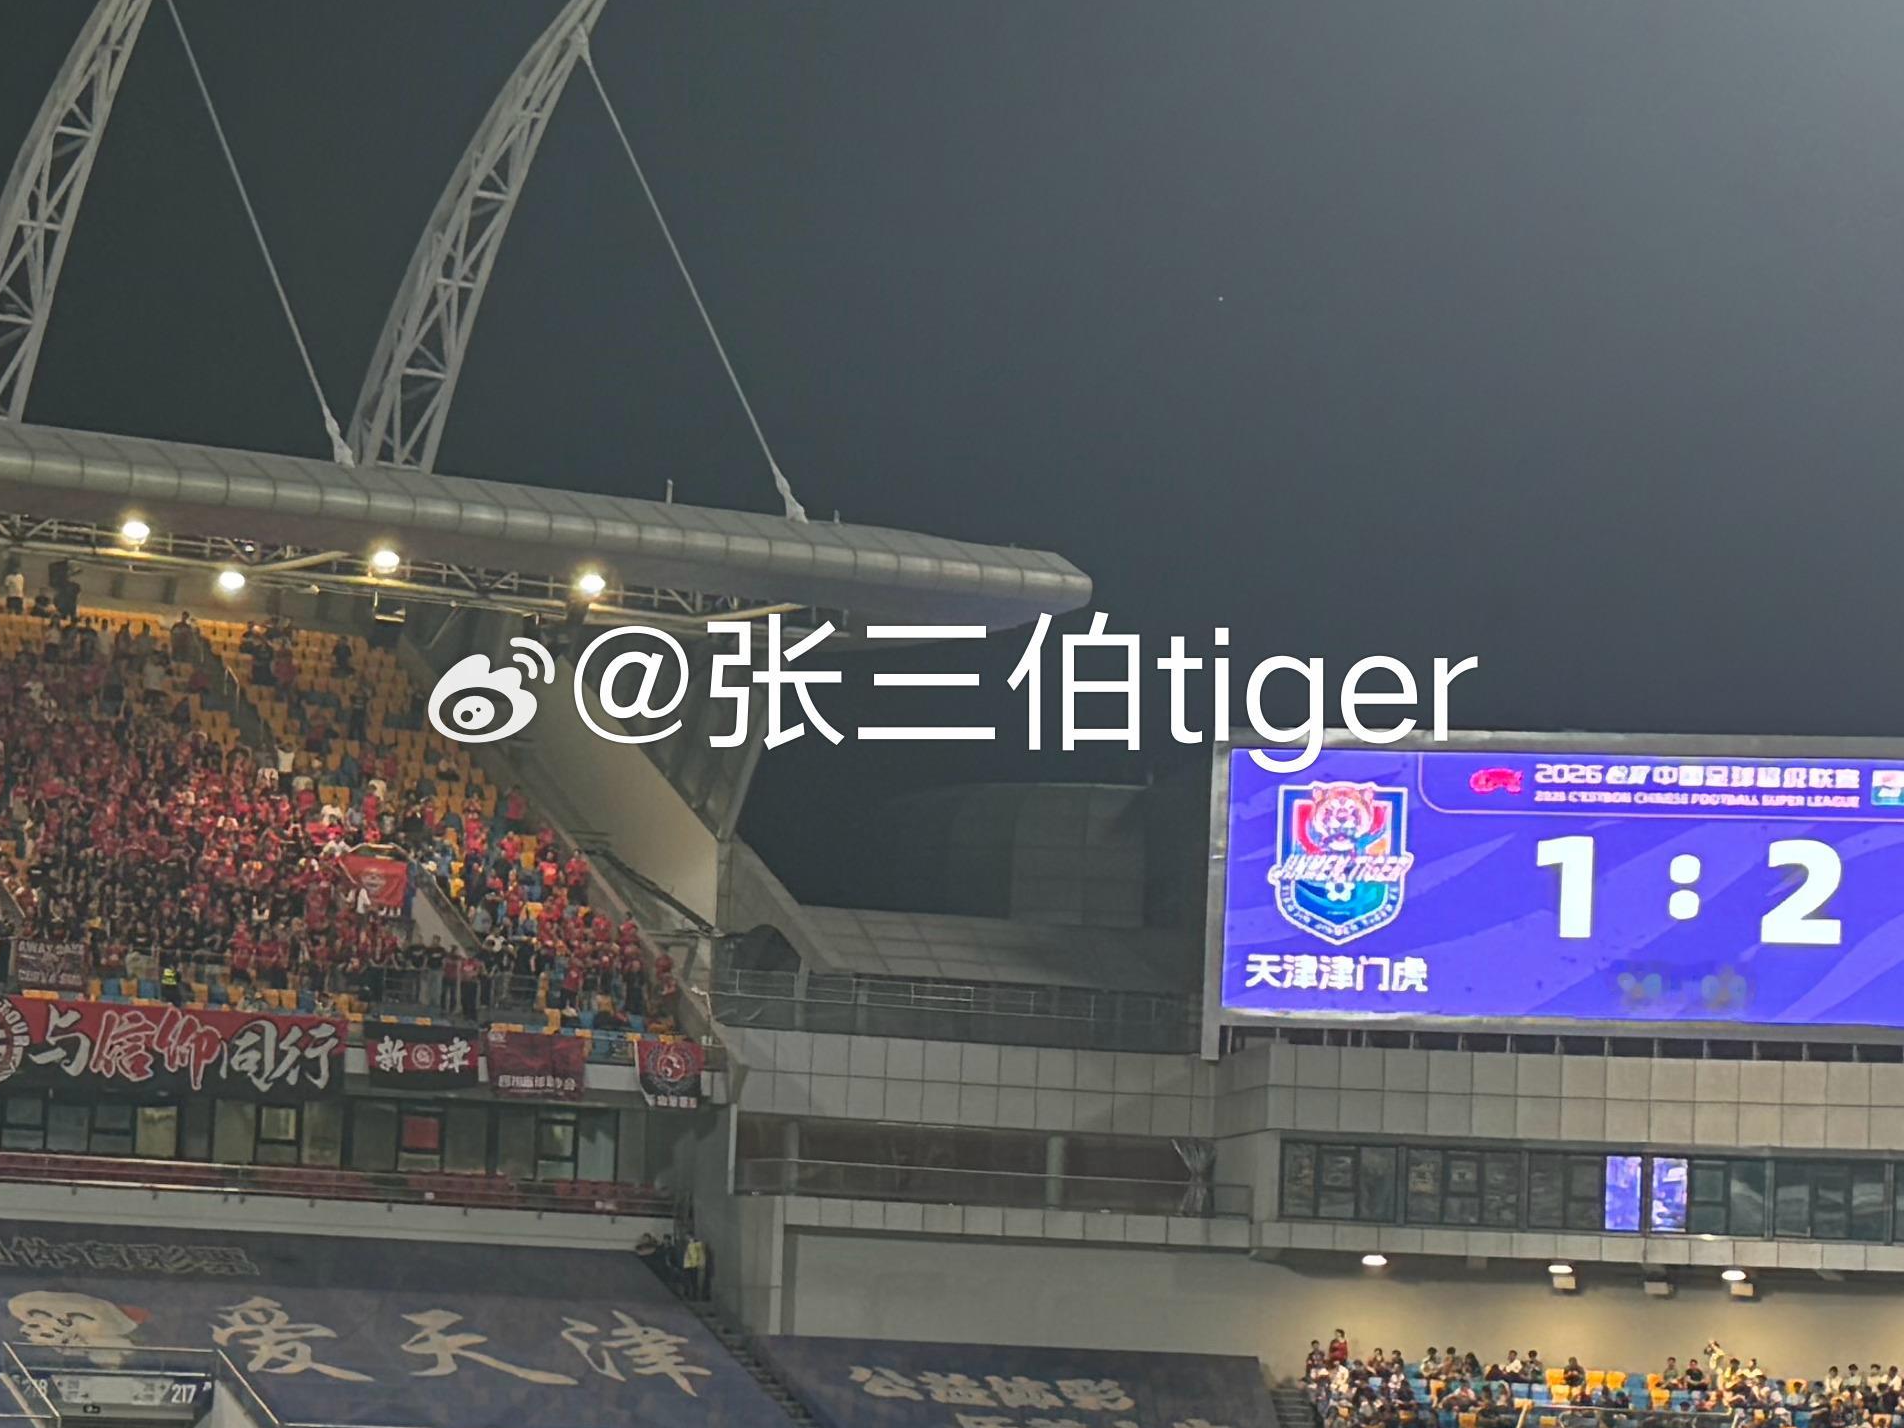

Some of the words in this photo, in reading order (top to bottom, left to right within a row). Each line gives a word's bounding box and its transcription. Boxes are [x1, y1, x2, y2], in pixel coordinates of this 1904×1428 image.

[1535, 835, 1596, 939] 1
[1759, 839, 1842, 946] 2
[1245, 954, 1429, 992] 天津津门虎
[171, 1383, 197, 1404] 217
